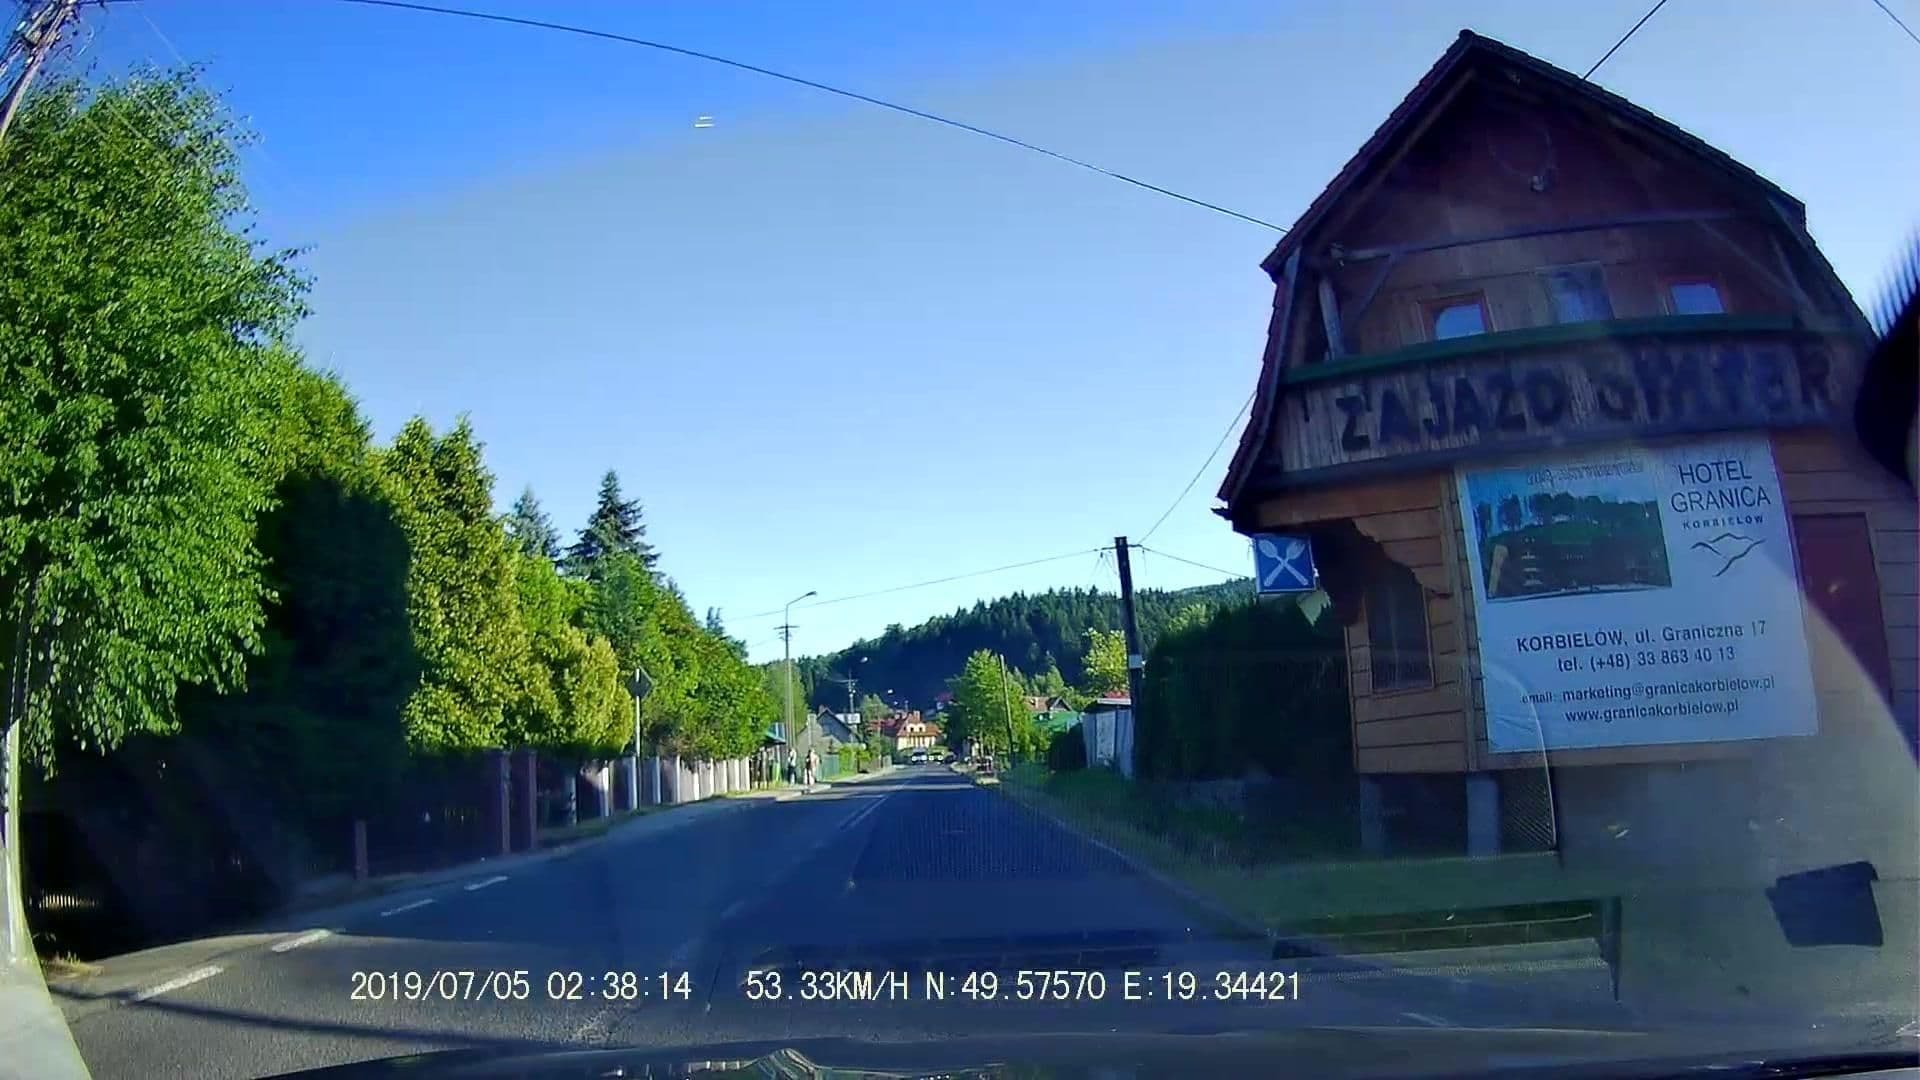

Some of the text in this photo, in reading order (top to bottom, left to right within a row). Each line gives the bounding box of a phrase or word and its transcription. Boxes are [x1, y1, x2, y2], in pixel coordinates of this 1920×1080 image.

[1678, 460, 1753, 485] HOTEL
[1670, 485, 1772, 513] GRANICA
[1635, 628, 1656, 643] ul.
[1558, 656, 1583, 673] tel.
[1591, 652, 1630, 673] (+48)
[1637, 651, 1657, 667] 33
[1661, 648, 1690, 665] 863
